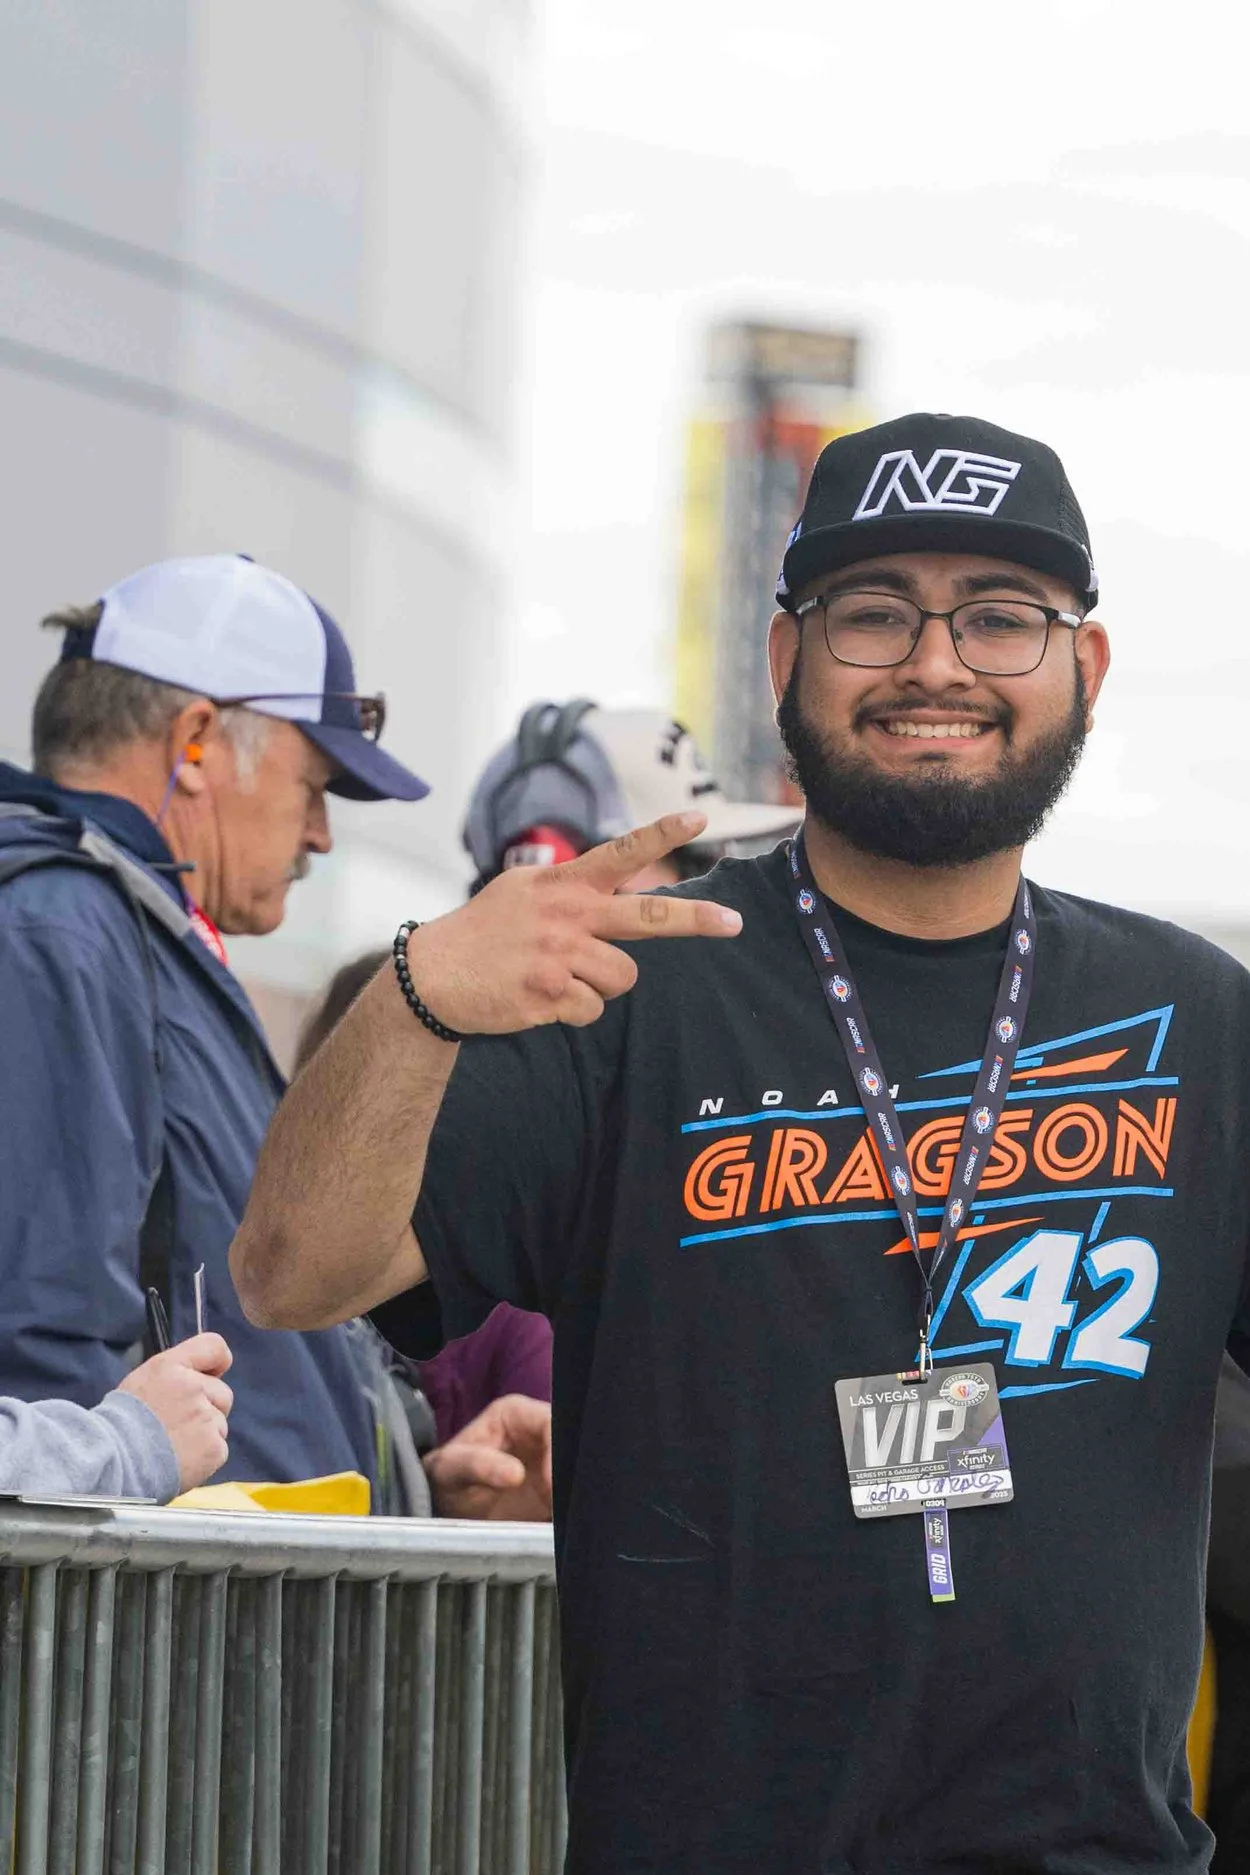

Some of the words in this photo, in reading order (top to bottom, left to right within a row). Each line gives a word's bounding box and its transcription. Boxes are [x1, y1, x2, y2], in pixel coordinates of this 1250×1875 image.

[852, 449, 1022, 520] NG
[846, 1017, 864, 1049] NASCAR
[987, 1062, 1002, 1093] NASCAR
[878, 1111, 895, 1144] NASCAR
[684, 1097, 1178, 1222] GRAGSON
[963, 1154, 977, 1185] NASCAR
[962, 1227, 1160, 1380] 42
[850, 1394, 874, 1407] LAS
[876, 1389, 919, 1403] VEGAS
[862, 1400, 967, 1468] VIP
[894, 1466, 919, 1475] GARAGE
[921, 1464, 945, 1472] ACCESS
[957, 1453, 995, 1468] xfinity
[861, 1503, 887, 1513] MARCH
[934, 1517, 944, 1544] xfinity
[932, 1553, 948, 1585] GRID
